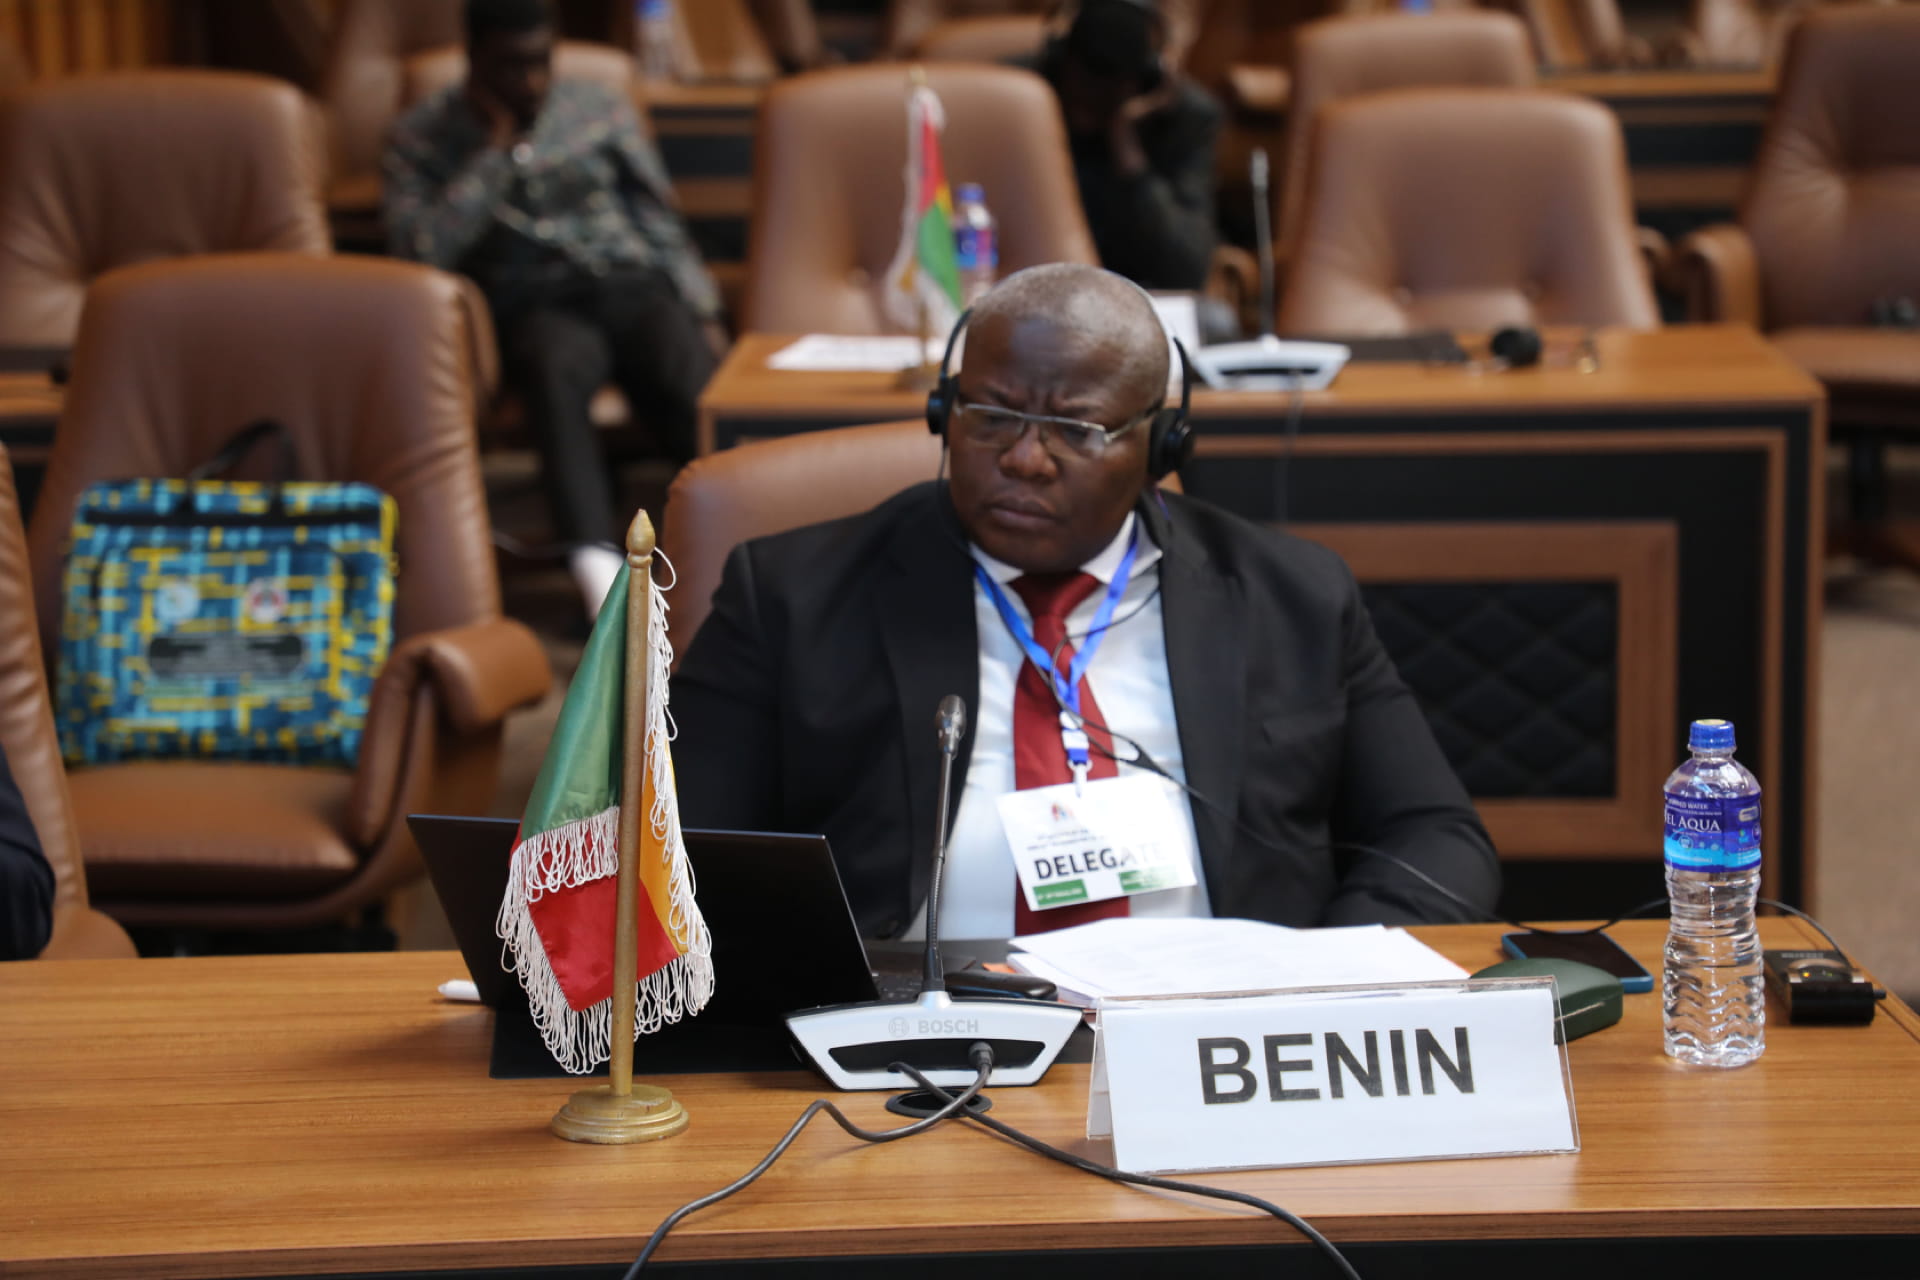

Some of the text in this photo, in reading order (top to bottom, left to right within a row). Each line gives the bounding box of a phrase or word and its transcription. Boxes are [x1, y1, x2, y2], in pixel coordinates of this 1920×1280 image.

[1678, 815, 1721, 833] AQUA
[918, 1018, 979, 1034] BOSCH
[1197, 1026, 1475, 1105] BENIN
